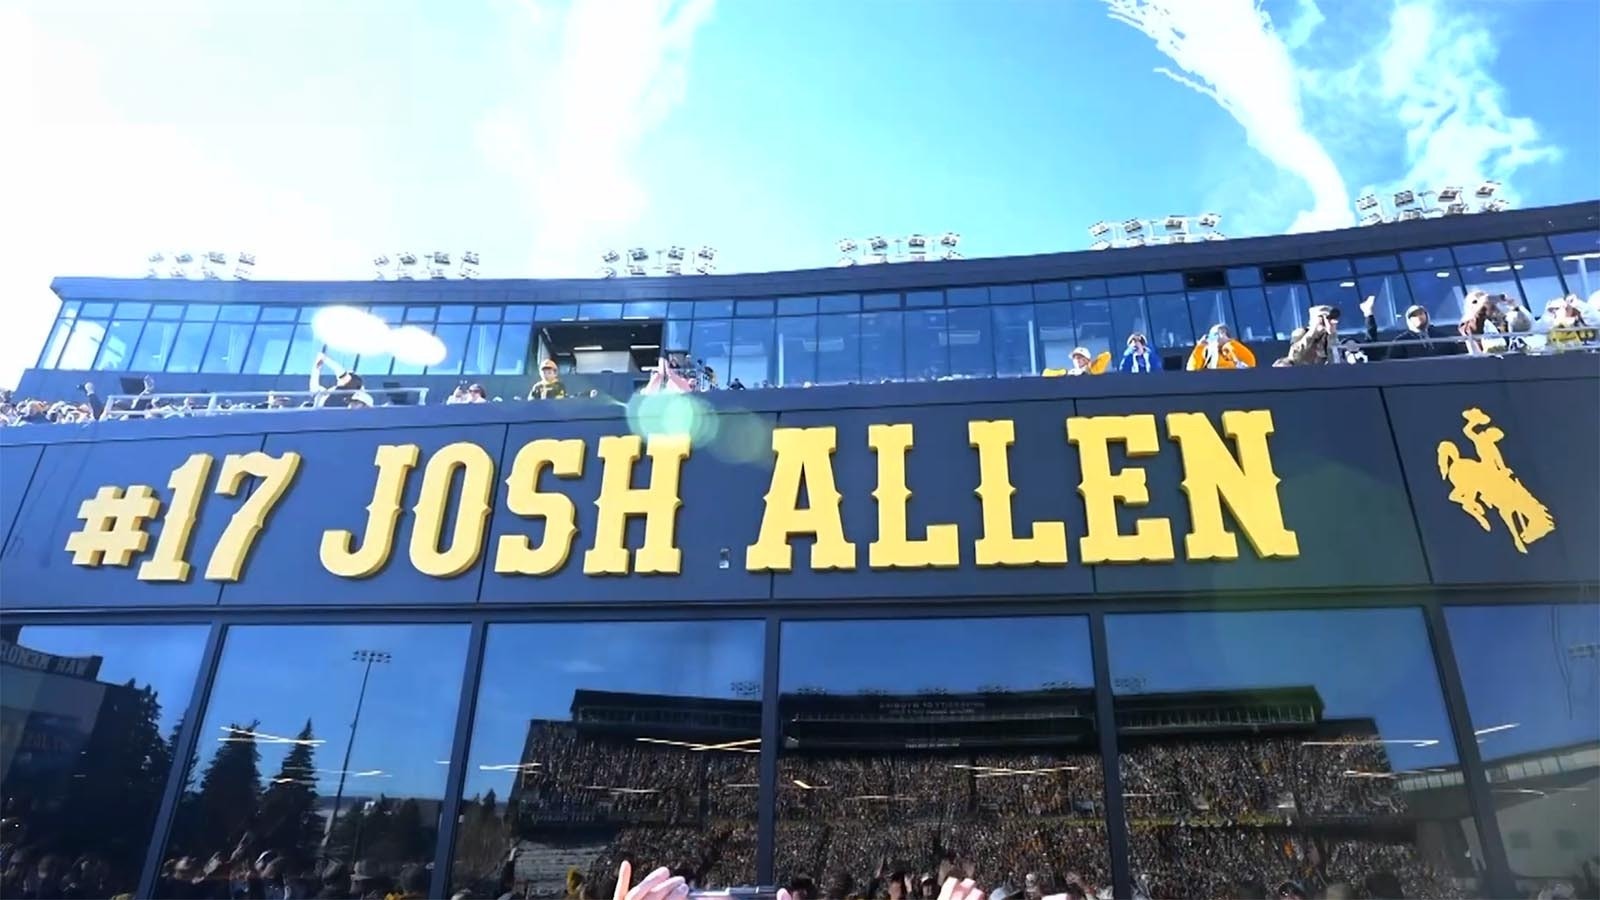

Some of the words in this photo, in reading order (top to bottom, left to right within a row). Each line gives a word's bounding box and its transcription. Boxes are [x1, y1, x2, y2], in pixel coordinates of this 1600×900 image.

[65, 452, 300, 582] #17
[319, 434, 690, 578] JOSH
[746, 410, 1299, 571] ALLEN
